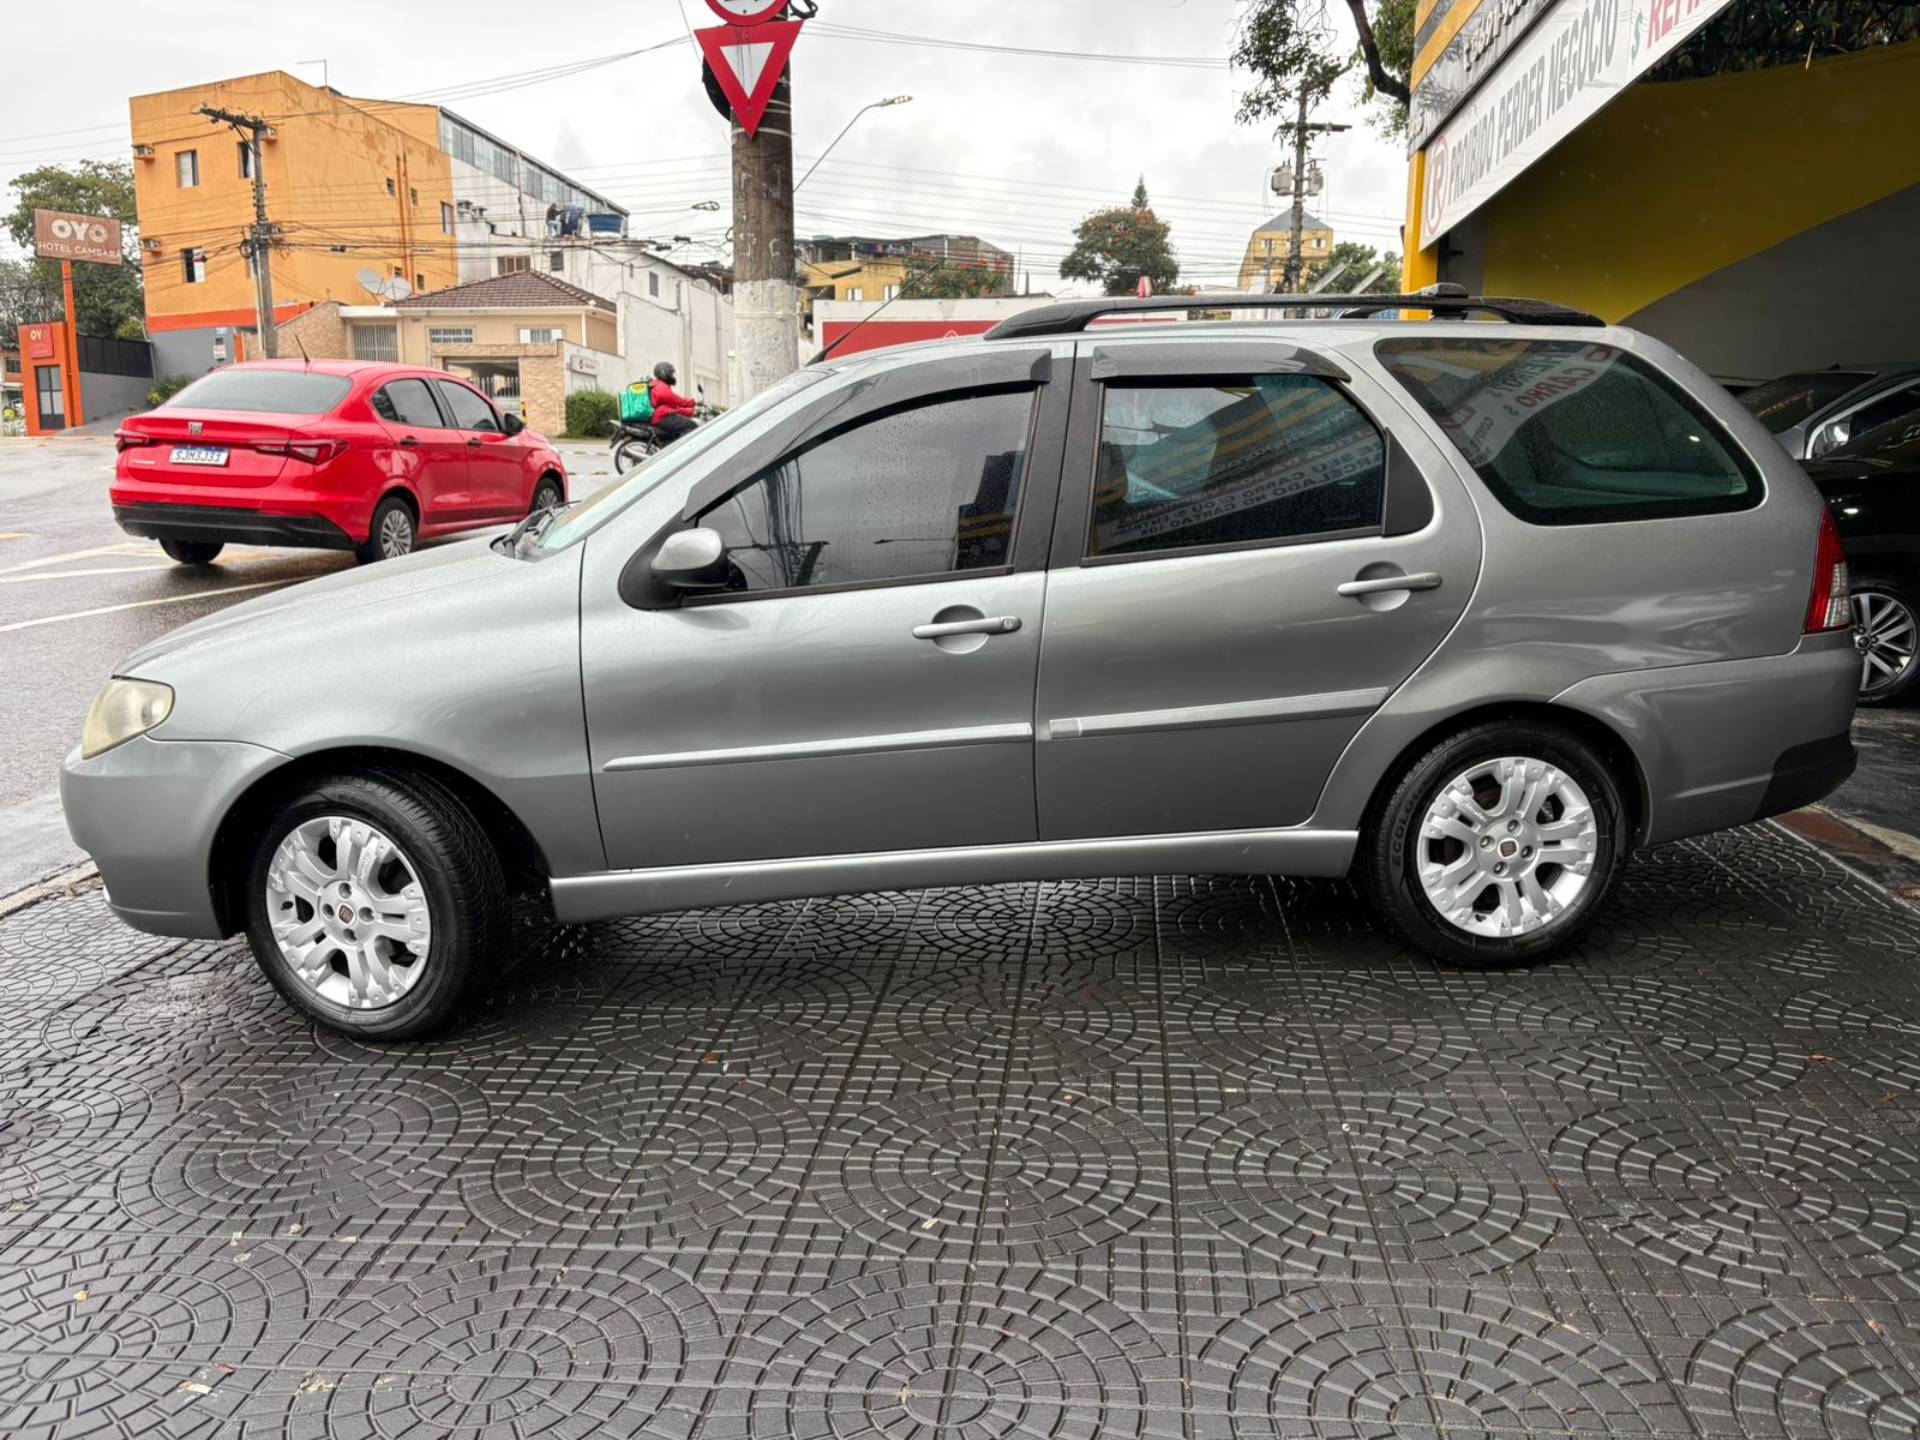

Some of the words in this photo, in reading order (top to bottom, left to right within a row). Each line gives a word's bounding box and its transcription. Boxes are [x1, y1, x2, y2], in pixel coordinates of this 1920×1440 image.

[1447, 105, 1496, 206] PROIBIDO
[1496, 54, 1545, 164] PERDER
[51, 219, 109, 244] OYO
[38, 241, 72, 253] HOTEL
